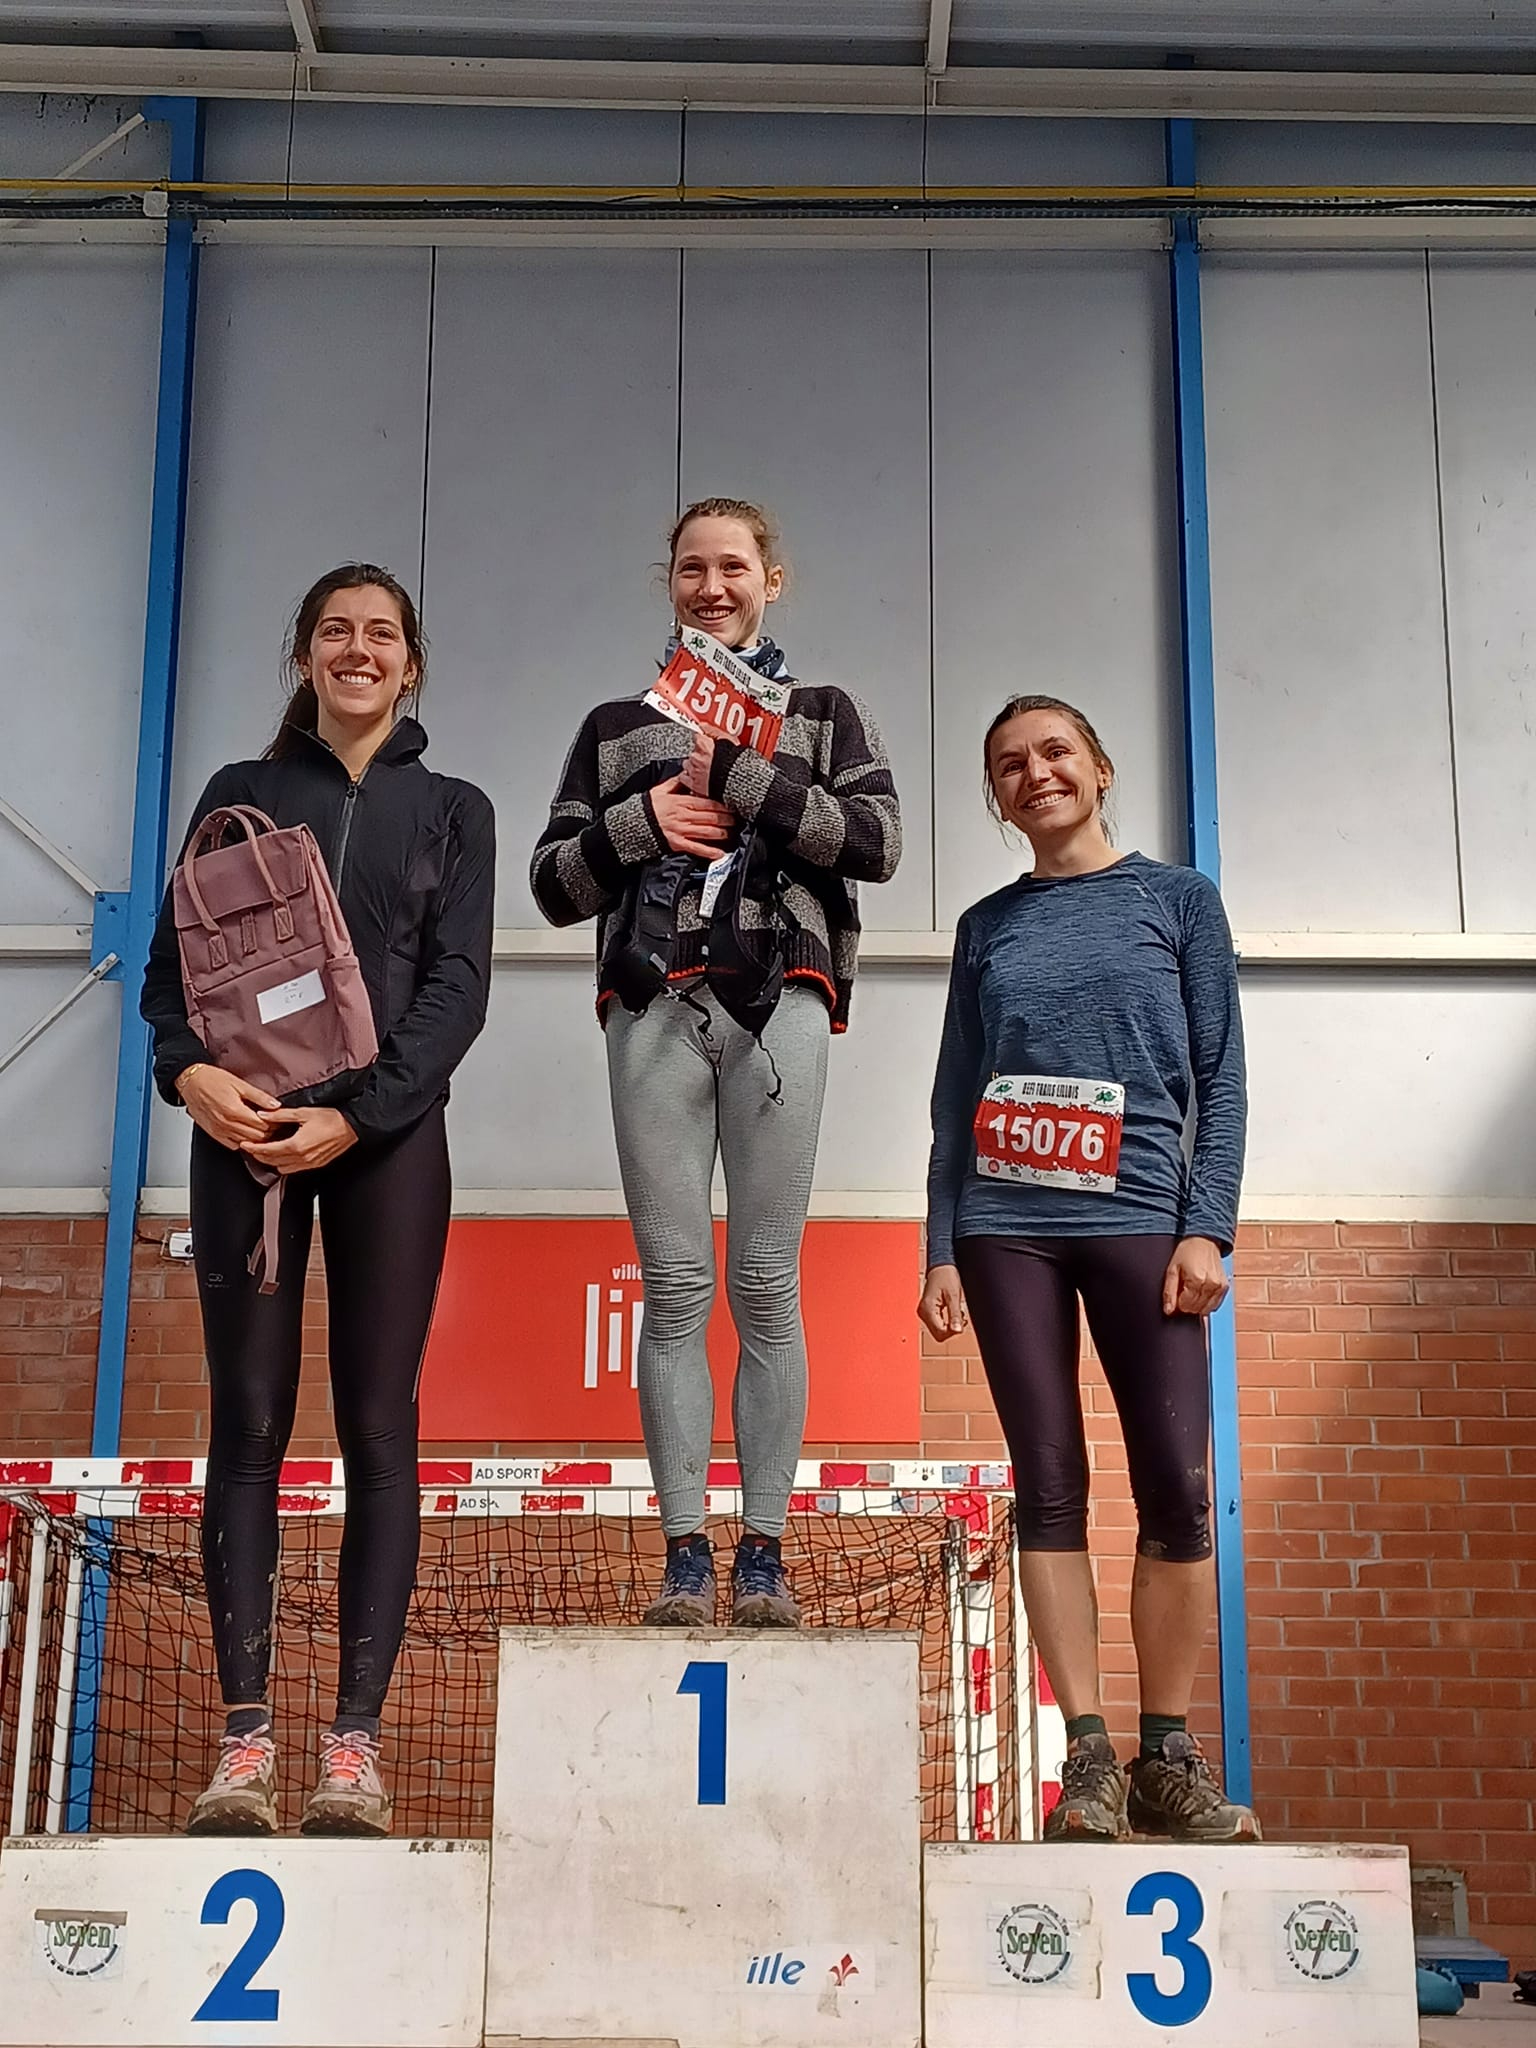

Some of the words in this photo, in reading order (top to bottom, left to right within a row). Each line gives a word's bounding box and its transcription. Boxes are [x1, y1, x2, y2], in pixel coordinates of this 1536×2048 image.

[675, 668, 764, 748] 15101
[988, 1114, 1106, 1161] 15076
[474, 1468, 494, 1480] AD
[496, 1468, 540, 1480] SPORT
[460, 1498, 477, 1508] AD
[676, 1661, 729, 1806] 1
[54, 1920, 111, 1948] Seven
[192, 1868, 285, 2021] 2
[1006, 1926, 1063, 1956] Seven
[1126, 1871, 1213, 2026] 3
[1294, 1922, 1352, 1953] Seven
